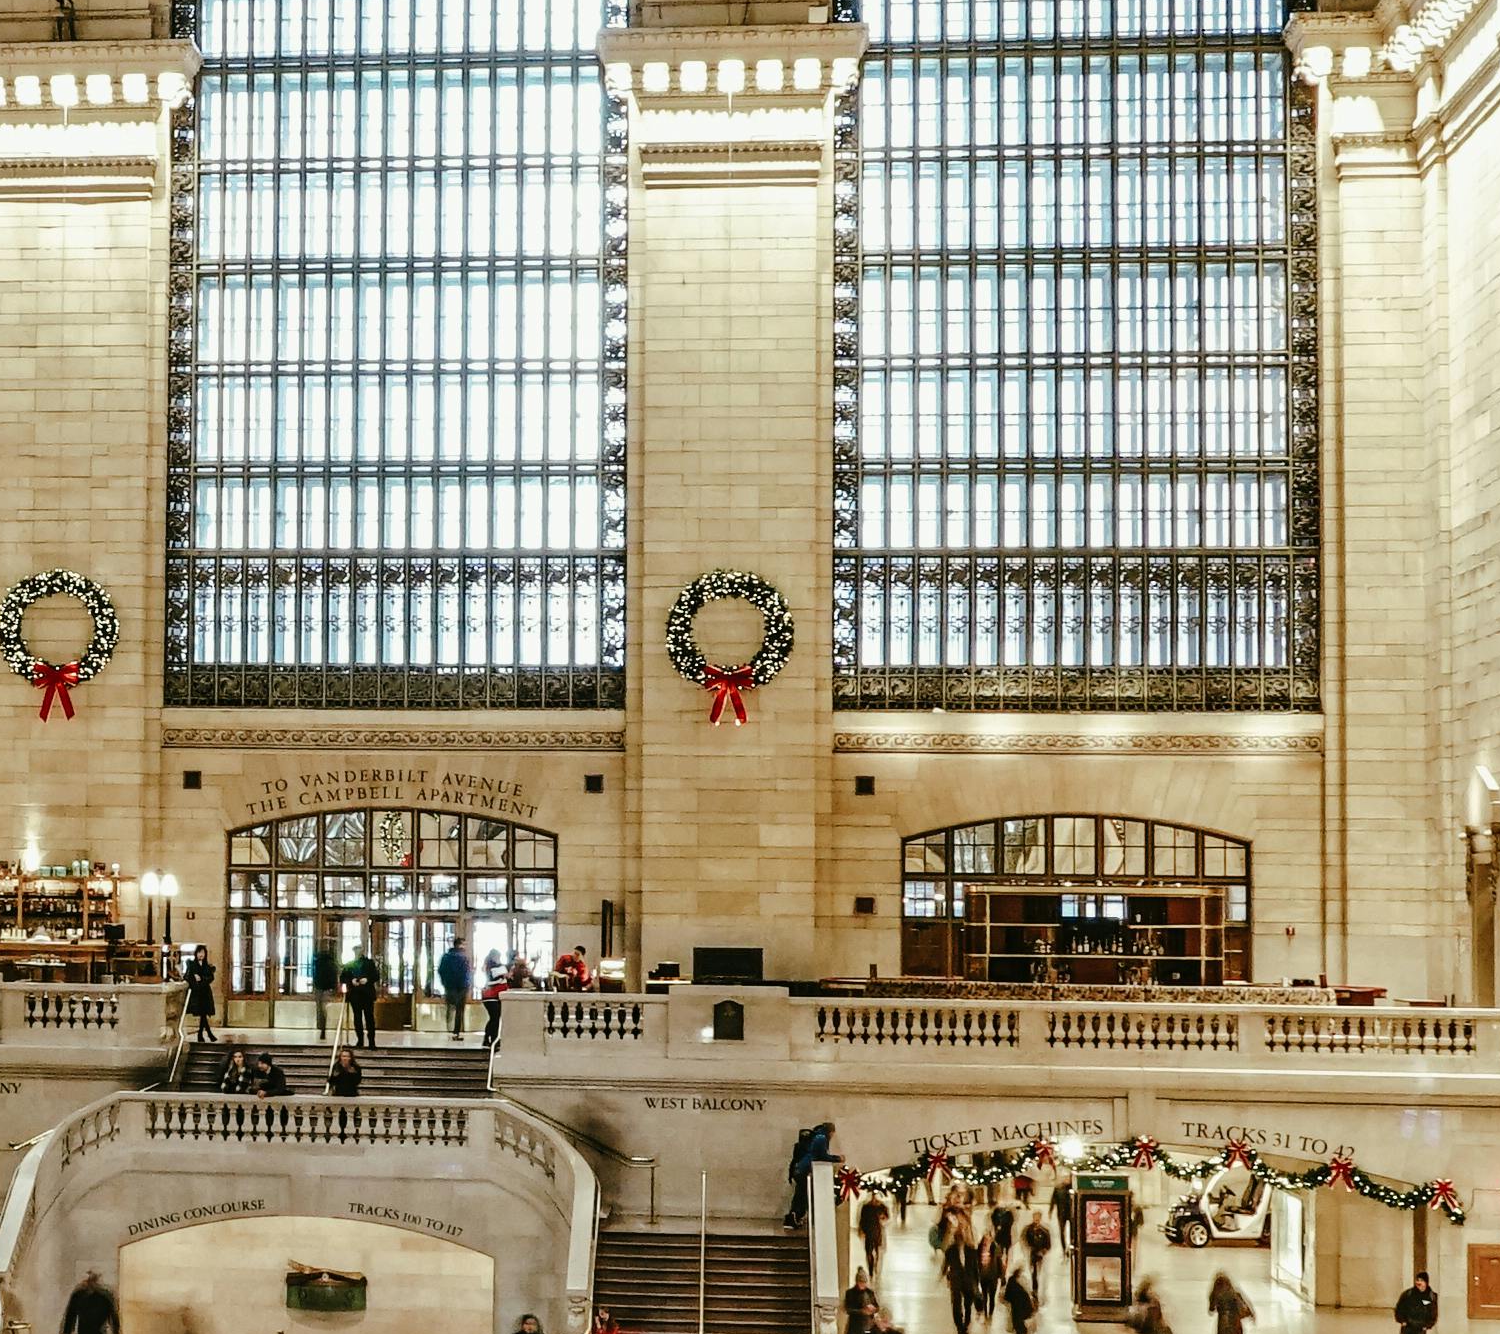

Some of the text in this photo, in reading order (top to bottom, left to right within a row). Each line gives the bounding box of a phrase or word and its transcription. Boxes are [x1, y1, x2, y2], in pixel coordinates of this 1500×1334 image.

[262, 769, 523, 797] TO VANDERBILT AVENUE
[246, 786, 538, 818] THE CAMPBELL APARTMENT
[644, 1097, 768, 1112] WEST BALCONY
[908, 1119, 1105, 1154] TICKET MACHINES
[1182, 1121, 1355, 1159] TRACKS 31 TO 42
[128, 1199, 266, 1236] DINING CONCOURSE
[348, 1202, 464, 1237] TRACKS 100 TO 117
